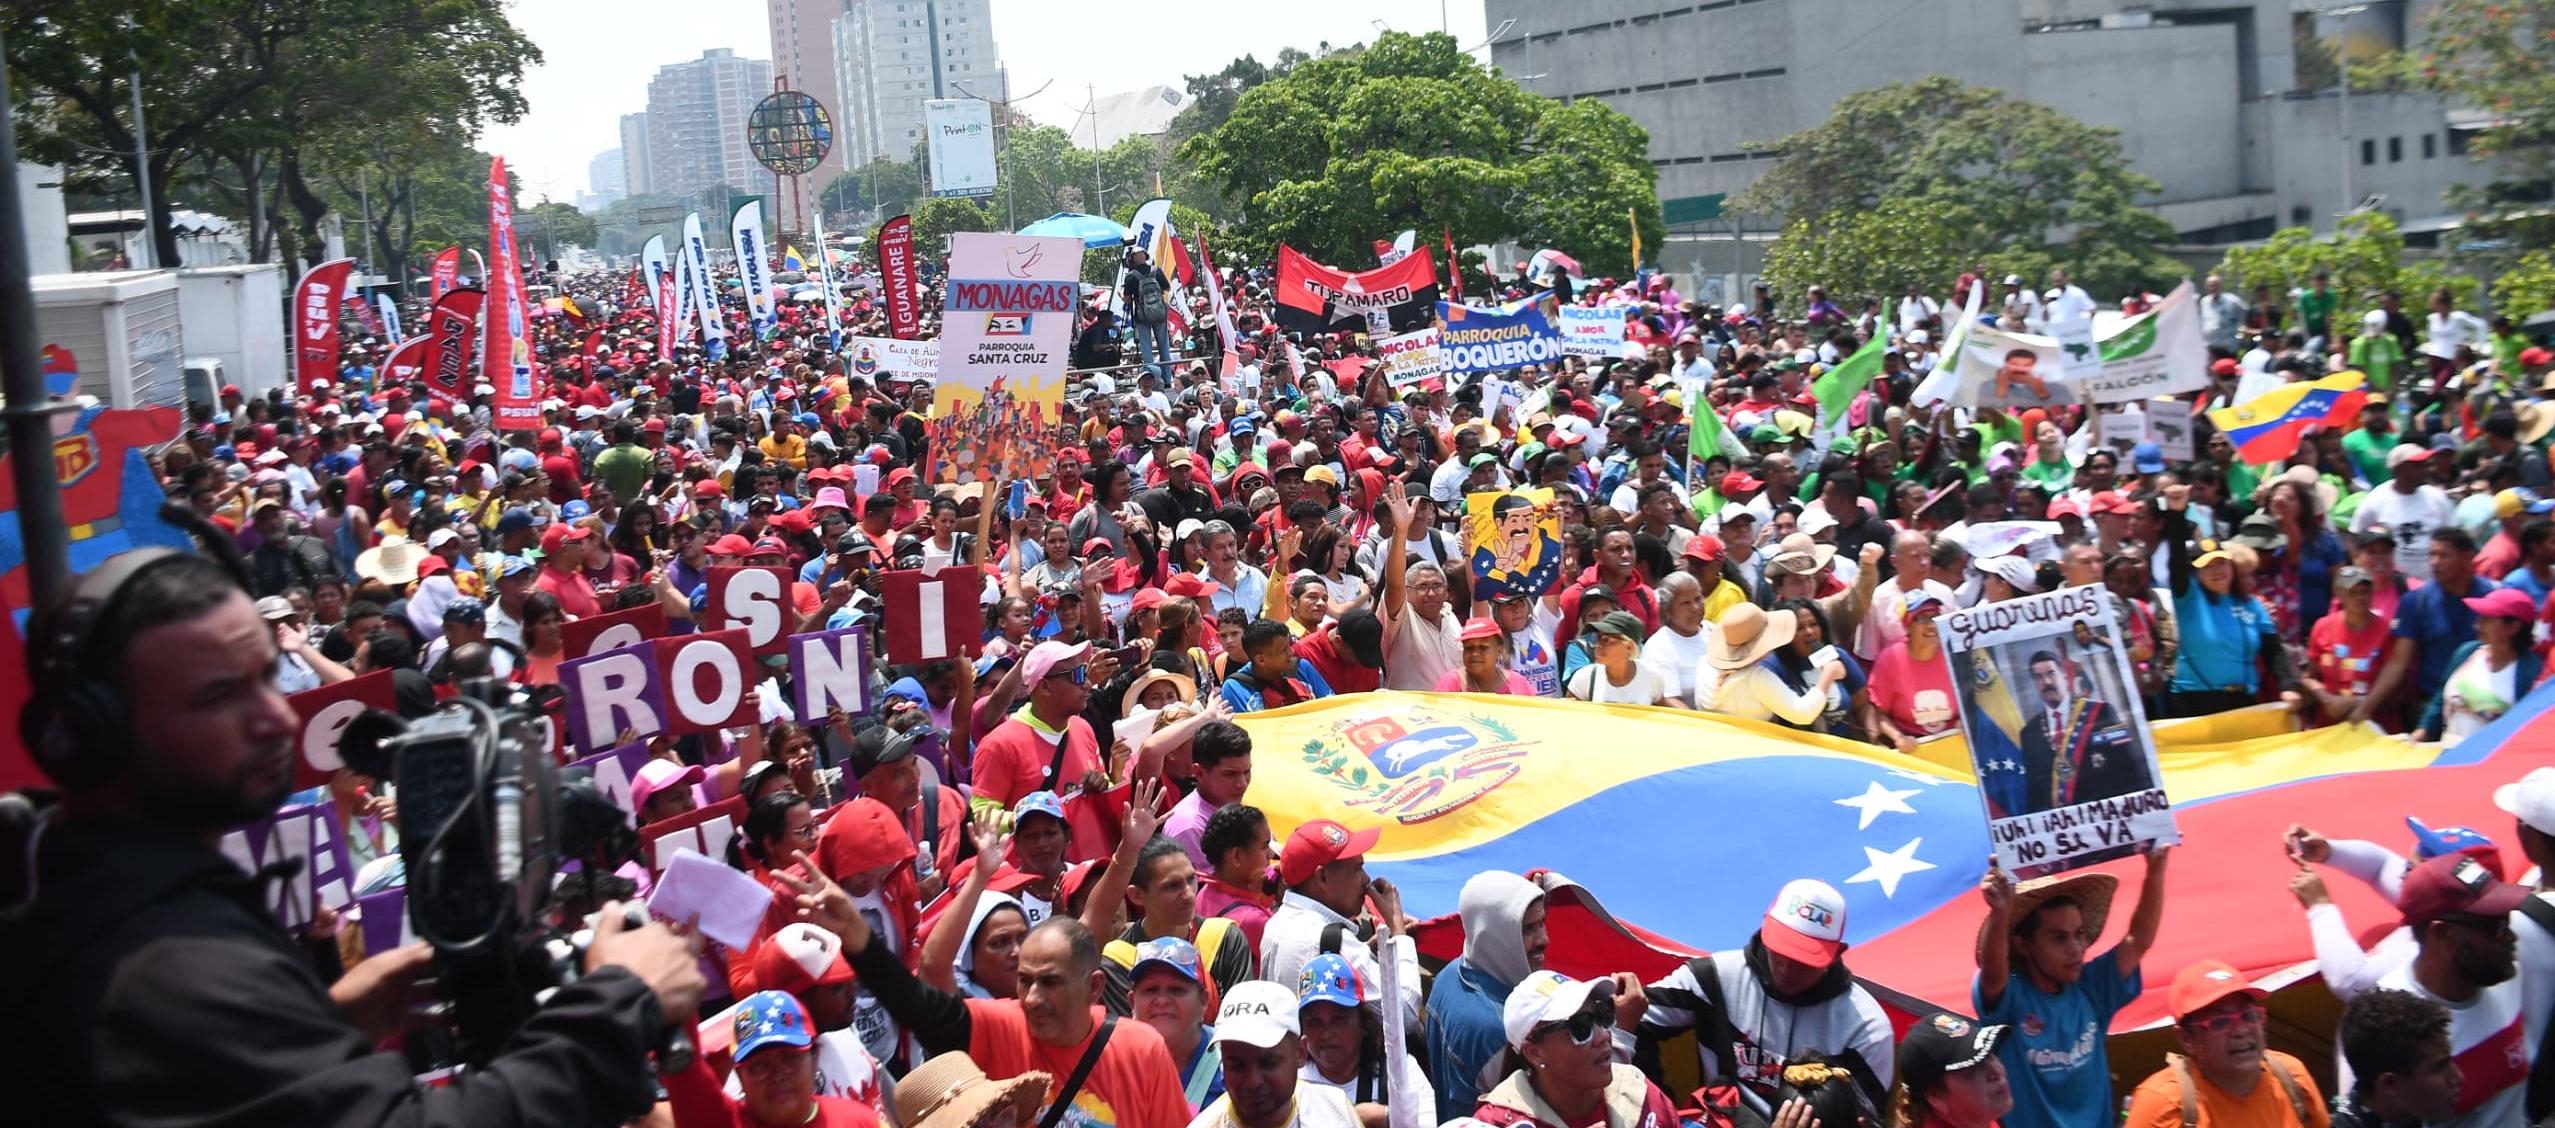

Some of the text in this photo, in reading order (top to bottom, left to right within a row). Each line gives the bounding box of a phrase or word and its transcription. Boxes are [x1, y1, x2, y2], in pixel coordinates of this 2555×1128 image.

[889, 245, 914, 324] GUANARE
[955, 281, 1072, 312] MONAGAS
[1306, 280, 1410, 308] TUPAMARO
[1562, 307, 1622, 320] NICOLAS
[1442, 323, 1532, 345] PARROQUIA
[968, 353, 1049, 365] SANTA CRUZ
[979, 342, 1035, 352] PARROQUIA
[1440, 330, 1563, 372] BOQUERÓN
[1393, 365, 1441, 381] MONAGAS
[2095, 819, 2135, 846] VA
